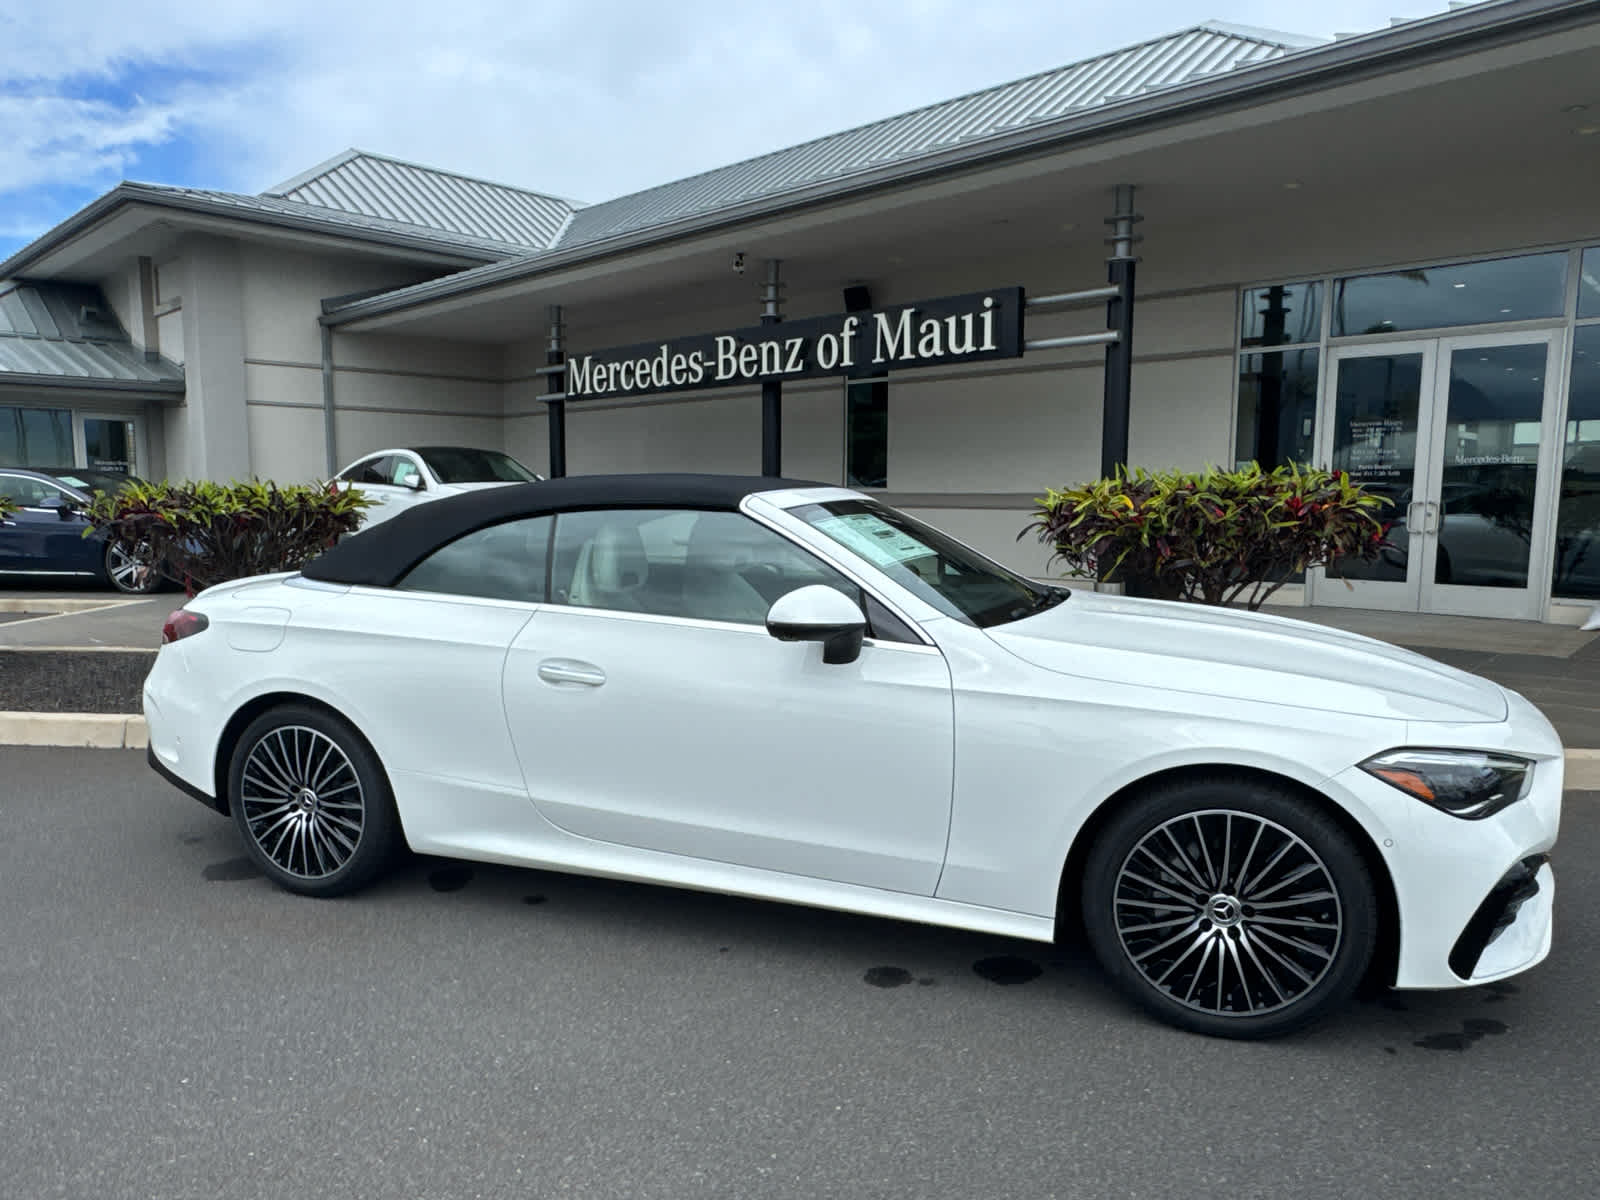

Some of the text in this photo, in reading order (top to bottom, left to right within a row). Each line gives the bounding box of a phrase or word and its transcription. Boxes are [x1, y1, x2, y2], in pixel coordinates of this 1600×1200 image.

[567, 297, 997, 396] Mercedes-Benz of Maui
